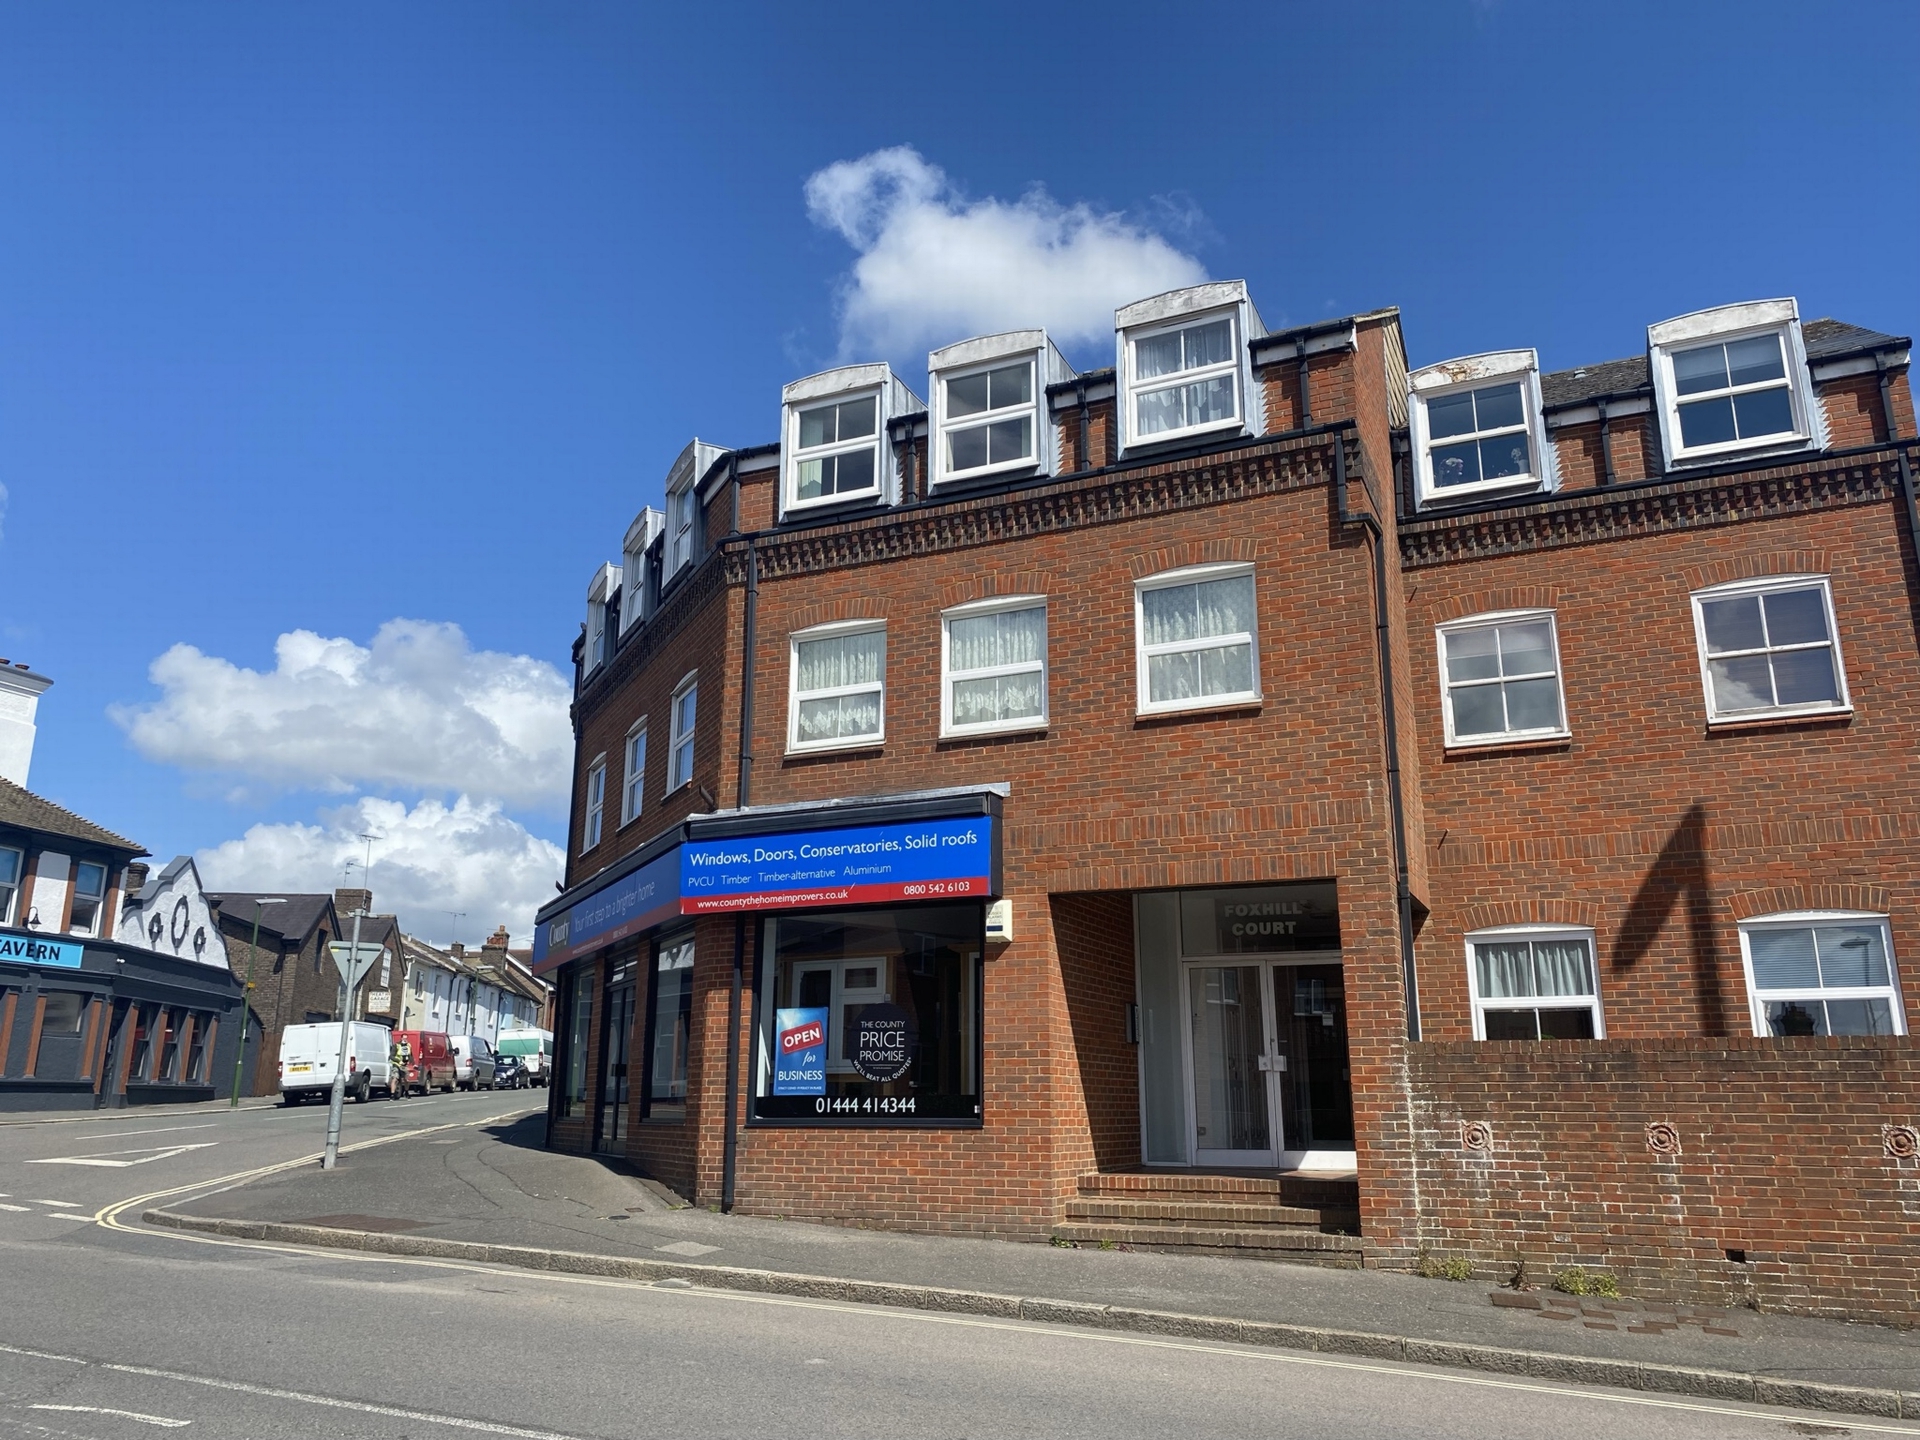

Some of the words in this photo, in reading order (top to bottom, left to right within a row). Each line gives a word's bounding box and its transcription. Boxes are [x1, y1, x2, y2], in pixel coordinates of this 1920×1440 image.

[690, 851, 752, 867] Windows,
[754, 848, 797, 862] Doors,
[800, 839, 902, 859] Conservatories,
[905, 833, 938, 850] Solid
[942, 830, 977, 847] roofs
[688, 876, 715, 888] PVCU
[721, 874, 751, 885] Timber
[758, 867, 836, 882] Timber-alternative
[843, 863, 892, 876] Aluminium
[637, 881, 655, 903] home
[903, 884, 926, 895] 0800
[928, 883, 945, 894] 542
[947, 881, 970, 893] 6103
[697, 889, 849, 909] www.countythehomeimprovers.co.uk
[1224, 902, 1303, 917] FOXHILL
[549, 918, 570, 947] County
[1231, 921, 1297, 936] COURT
[0, 939, 61, 961] AVERN
[875, 1020, 905, 1028] COUNTY
[784, 1027, 821, 1048] OPEN
[860, 1031, 905, 1048] PRICE
[802, 1051, 817, 1067] for
[860, 1050, 905, 1061] PROMISE
[778, 1070, 823, 1081] BUSINESS
[853, 1059, 865, 1076] WE'LL
[866, 1073, 880, 1082] BEAT
[815, 1097, 859, 1113] 01444
[862, 1097, 916, 1113] 414344
